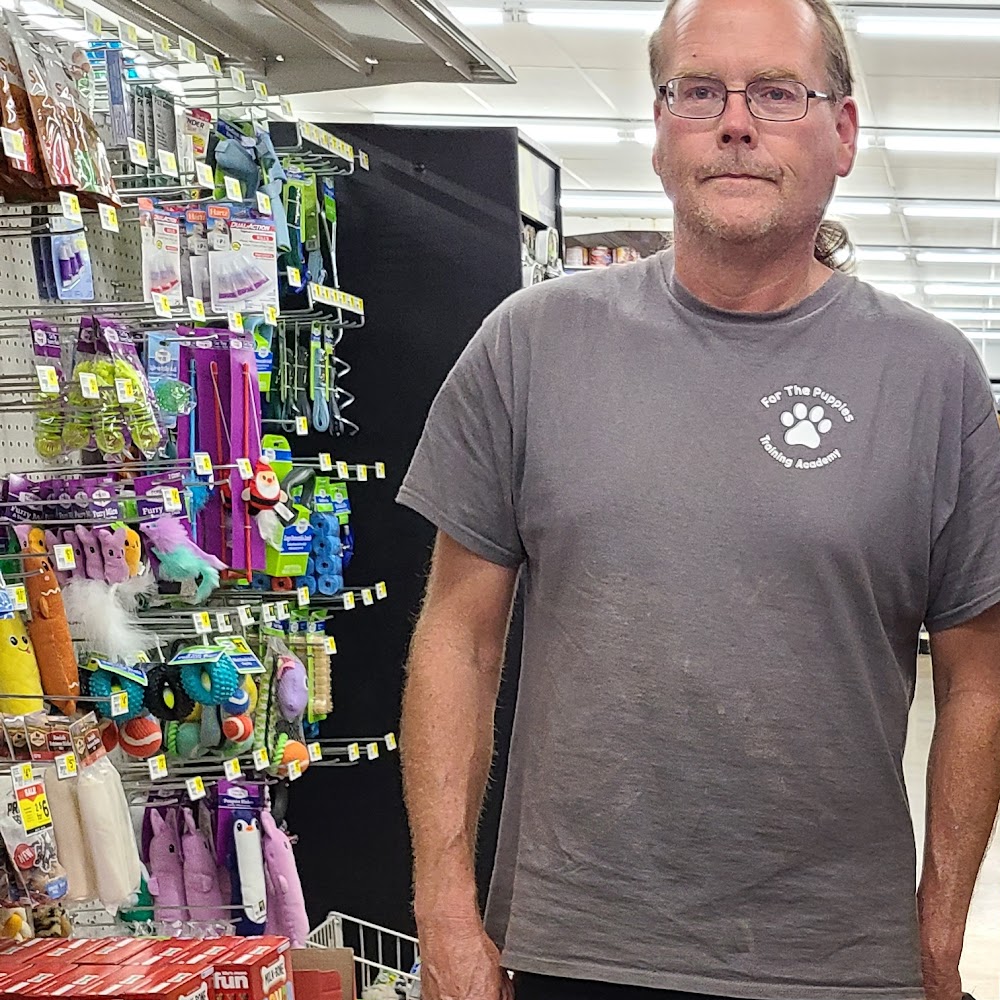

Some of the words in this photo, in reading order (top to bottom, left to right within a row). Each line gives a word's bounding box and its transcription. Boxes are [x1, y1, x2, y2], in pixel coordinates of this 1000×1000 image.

[760, 391, 782, 409] For
[784, 384, 811, 397] The
[812, 386, 855, 423] Puppies
[759, 434, 794, 468] Training
[794, 448, 842, 469] Academy
[17, 847, 35, 865] NEW
[213, 972, 249, 989] fun
